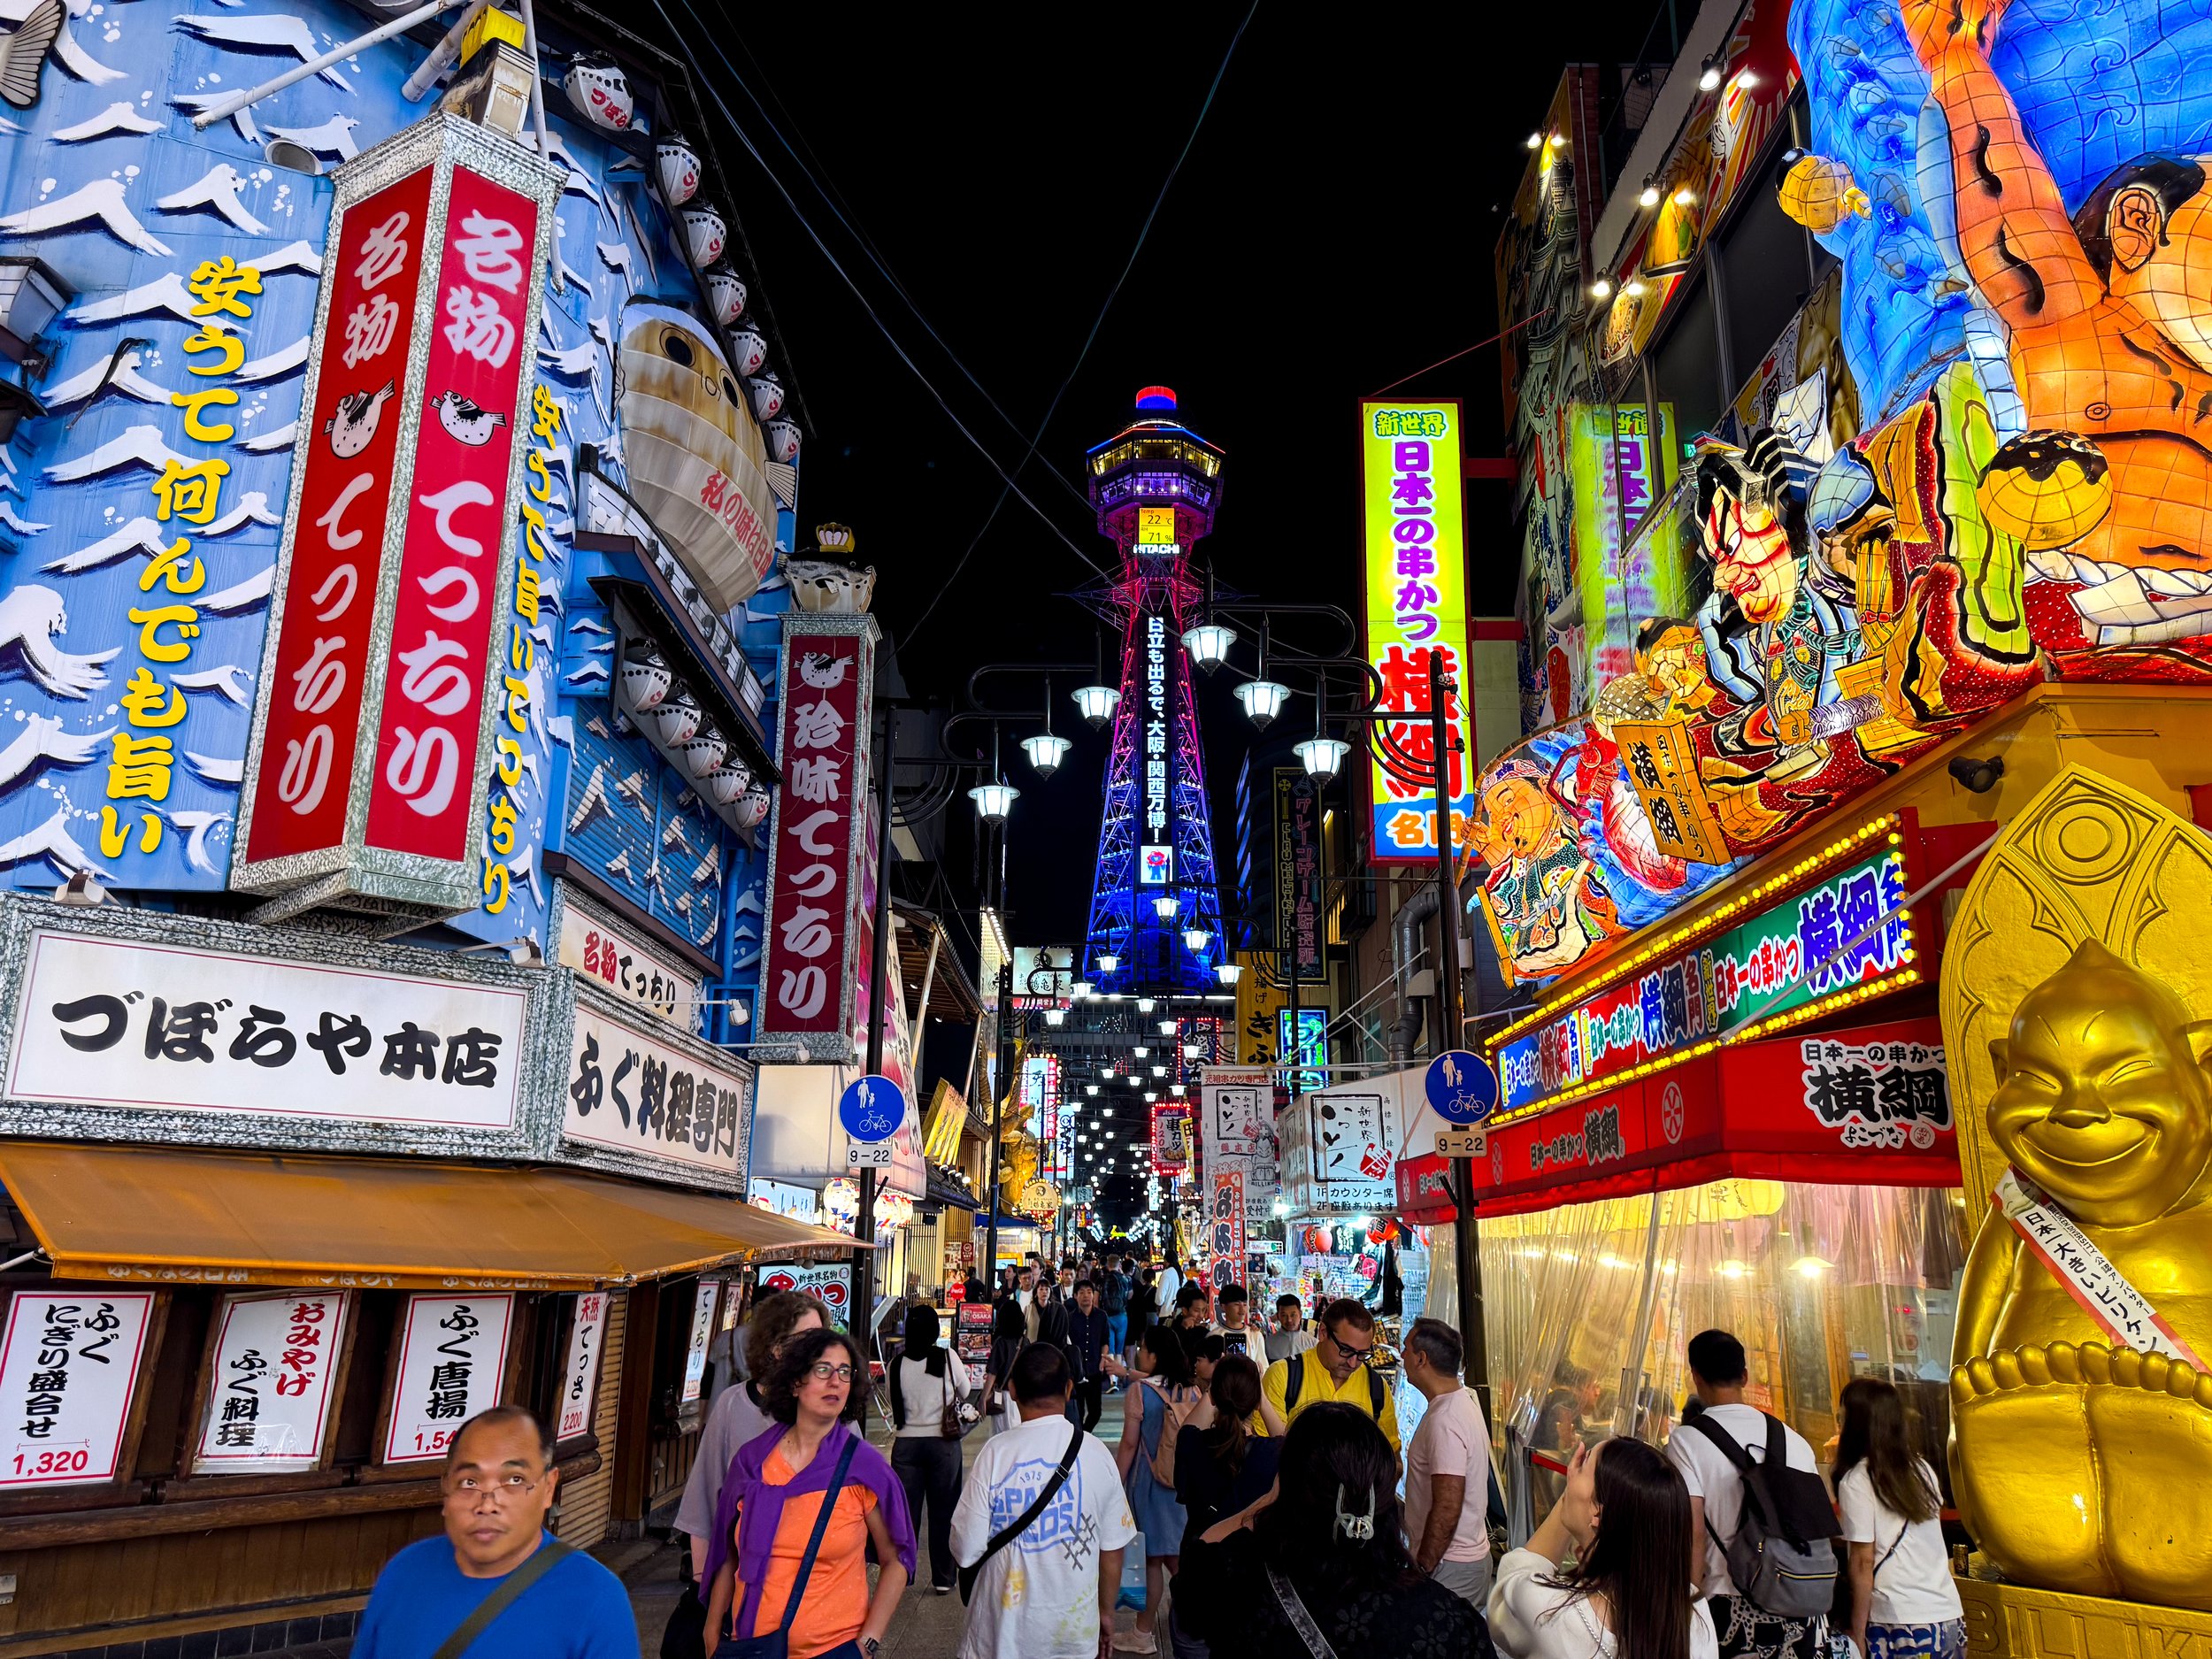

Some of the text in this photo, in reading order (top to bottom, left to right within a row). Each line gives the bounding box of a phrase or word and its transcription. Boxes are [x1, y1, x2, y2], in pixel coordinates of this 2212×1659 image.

[1376, 411, 1446, 437] 新世界
[1133, 544, 1180, 554] HITACHI
[1148, 515, 1161, 525] 22
[1148, 533, 1161, 541] 71
[1393, 442, 1440, 642] 日本一の串かつ
[99, 255, 264, 859] 安うて何んでも旨い
[278, 472, 374, 817] てっちり
[386, 480, 496, 818] てっちり
[778, 700, 845, 1018] 珍味てっちり
[1799, 868, 1884, 991] 横綱
[1714, 938, 1799, 1013] 日本一の串かつ
[51, 990, 503, 1088] づぼらや本店
[1806, 1043, 1947, 1064] 日本一の串かつ
[571, 1032, 738, 1160] ふぐ料理専門
[1205, 1074, 1269, 1084] 元祖串カツ専門店
[1808, 1064, 1949, 1125] 横綱
[1531, 1136, 1583, 1170] 日本一の串かつ
[1586, 1108, 1619, 1164] 横綱
[1845, 1125, 1903, 1144] よこづな
[1317, 1187, 1394, 1199] 1F カウンター席
[1317, 1202, 1326, 1210] 2F
[799, 1271, 837, 1283] 新世界名物
[2025, 1211, 2168, 1355] 日本一大きいビリケン
[80, 1303, 120, 1363] ふぐ
[580, 1296, 601, 1322] 天然
[19, 1304, 81, 1438] にぎり盛合せ
[276, 1302, 325, 1396] おみやげ
[426, 1305, 480, 1420] ふぐ唐揚
[571, 1325, 593, 1401] てっさ
[216, 1348, 267, 1447] ふぐ料理
[13, 1450, 88, 1476] 1,320
[415, 1431, 456, 1452] 1,54
[1020, 1471, 1041, 1483] 1975
